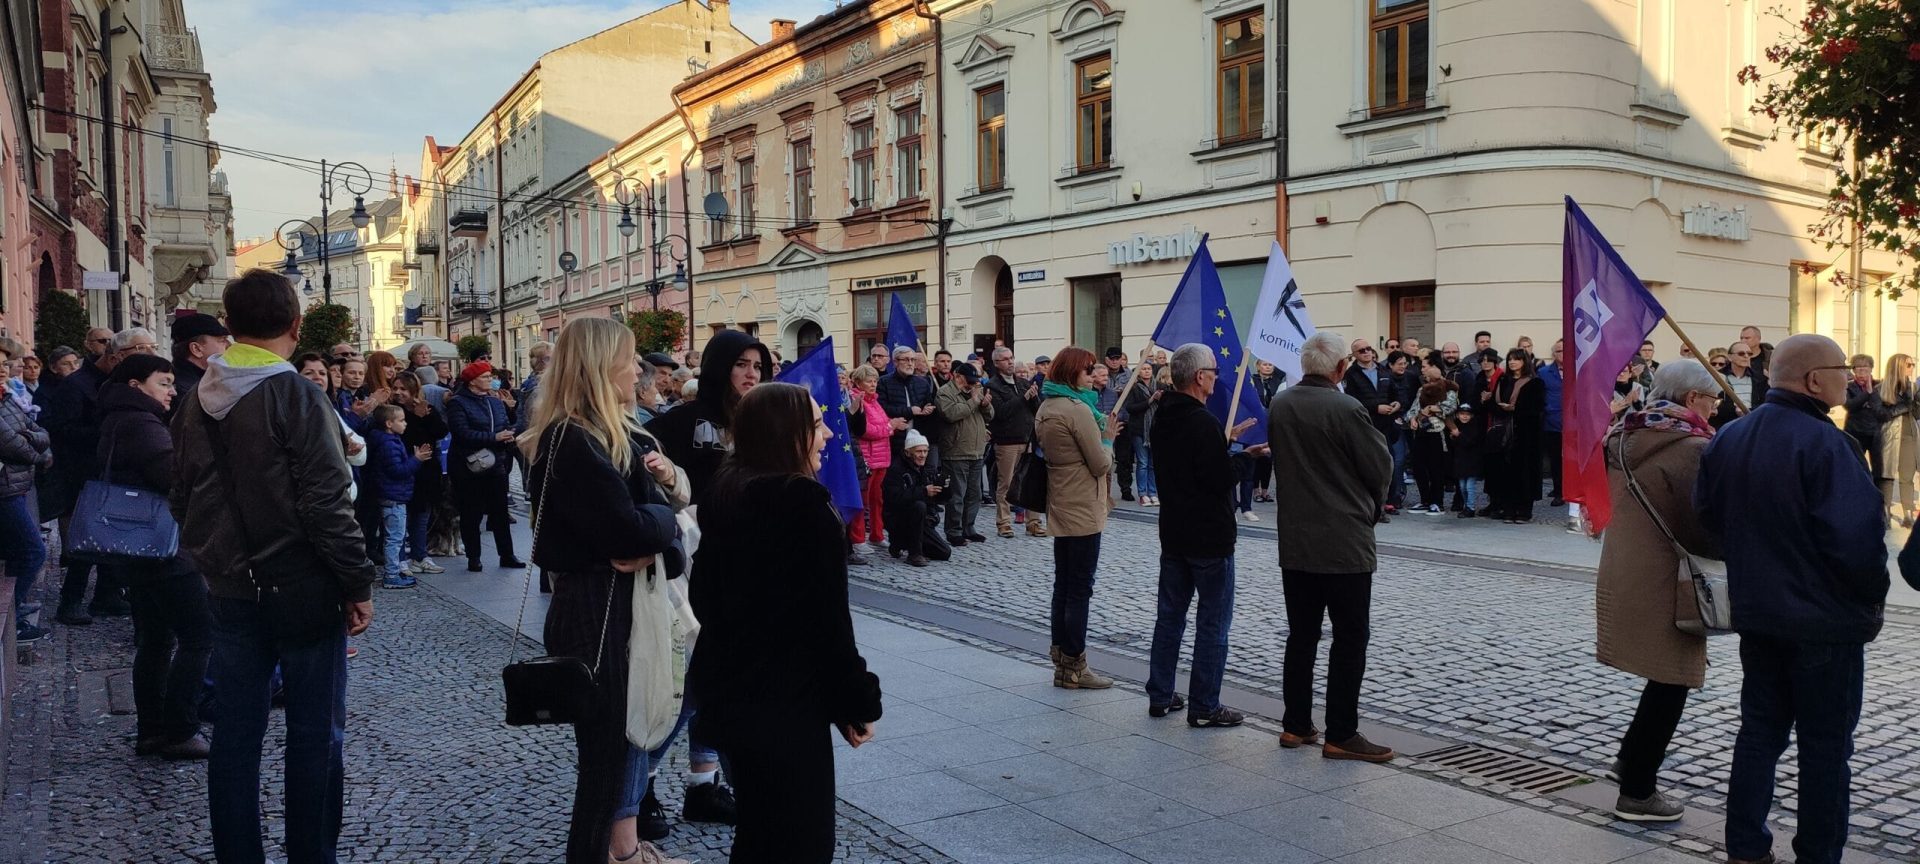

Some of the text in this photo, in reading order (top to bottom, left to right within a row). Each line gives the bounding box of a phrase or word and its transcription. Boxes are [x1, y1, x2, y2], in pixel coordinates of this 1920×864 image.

[1681, 202, 1750, 241] mBank
[1107, 224, 1200, 266] mBank
[955, 277, 962, 287] 25
[1259, 328, 1301, 356] komite
